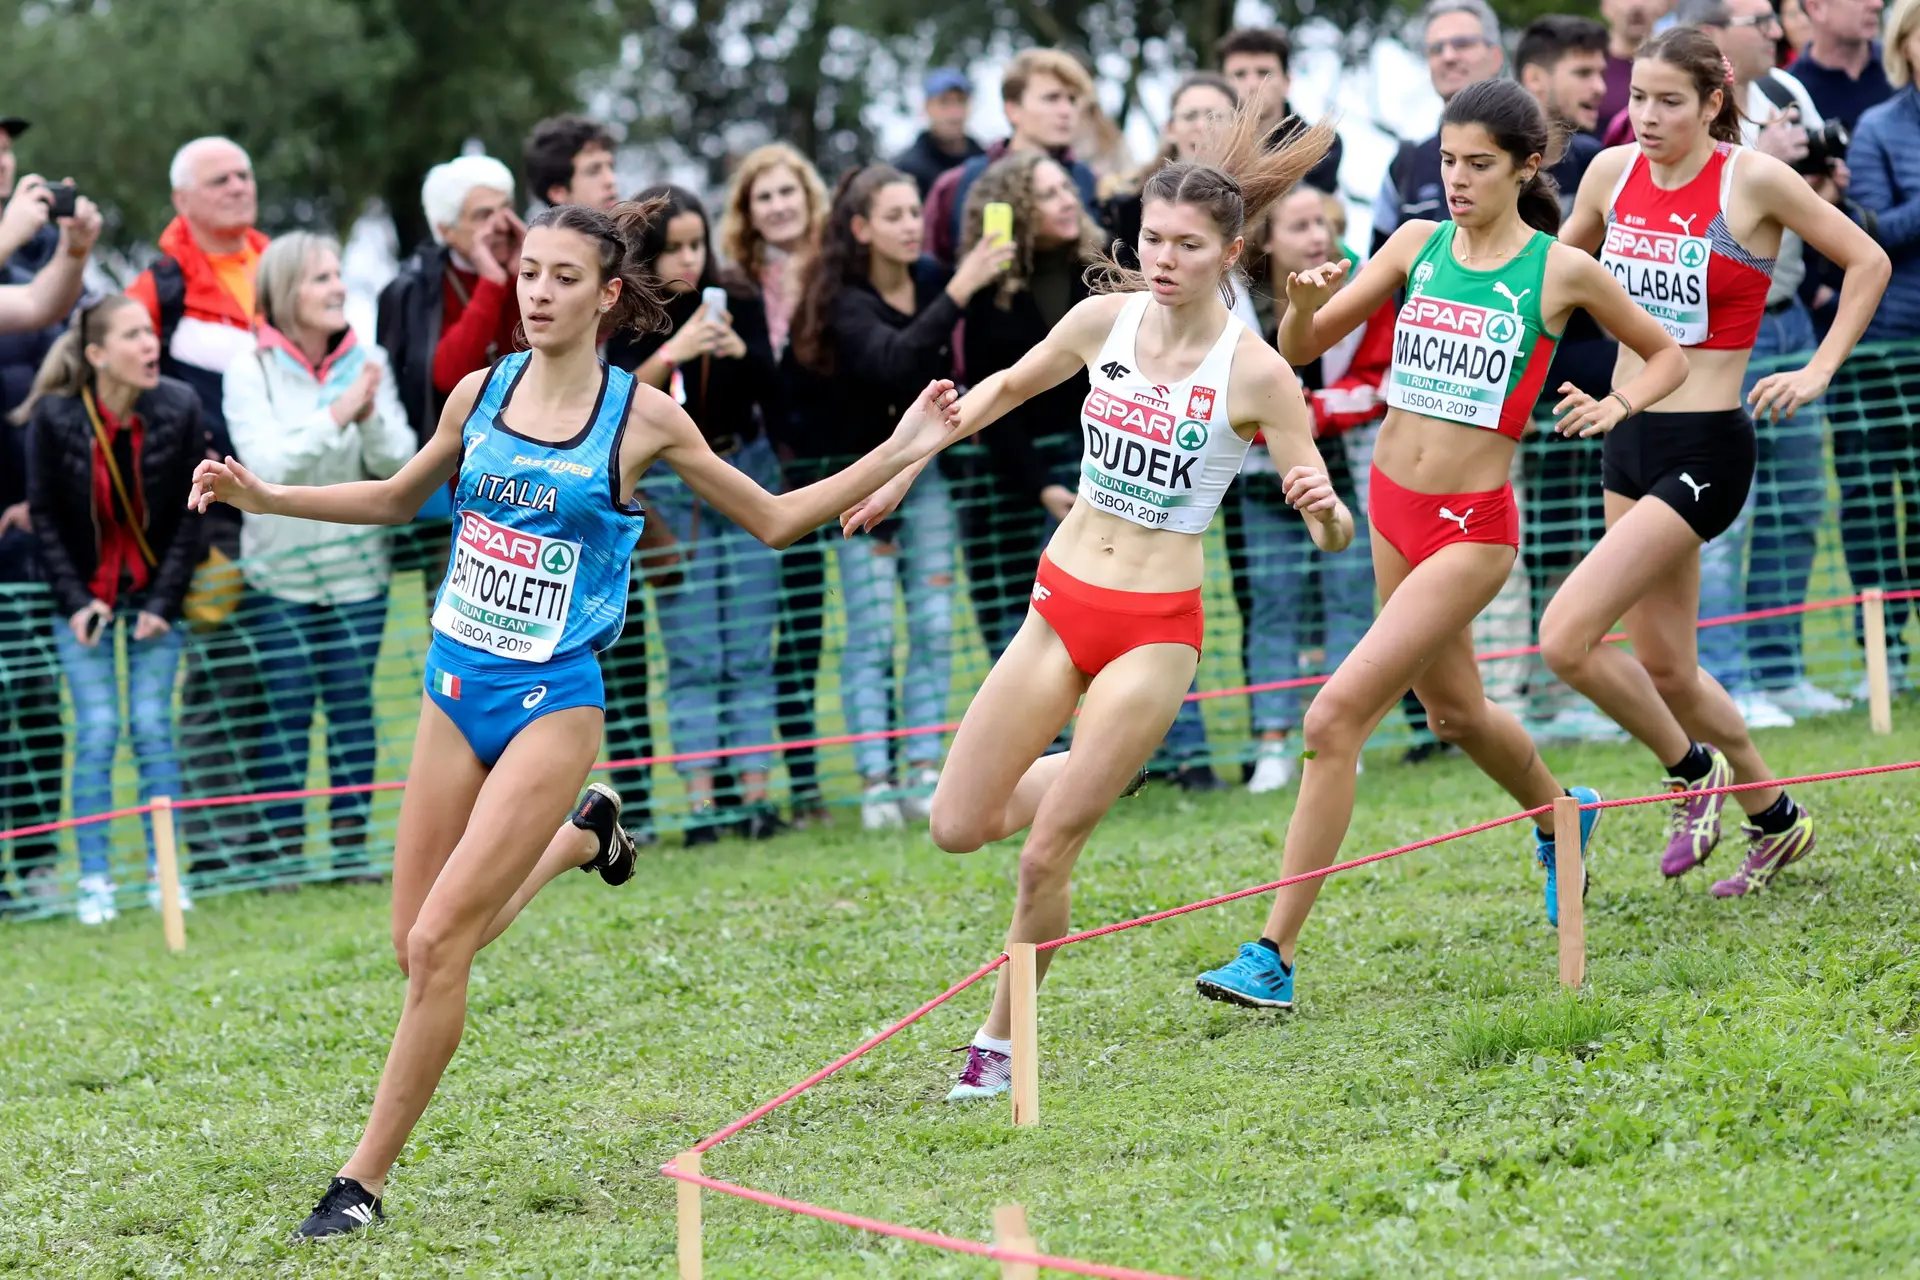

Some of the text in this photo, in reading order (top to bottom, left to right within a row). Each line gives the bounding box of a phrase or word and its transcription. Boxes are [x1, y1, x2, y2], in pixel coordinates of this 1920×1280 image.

[1606, 229, 1675, 261] SPAR
[1400, 299, 1483, 335] SPAR
[1395, 330, 1507, 384] MACHADO
[1406, 375, 1411, 385] I
[1411, 376, 1435, 390] RUN
[1086, 393, 1173, 440] SPAR
[1402, 391, 1478, 417] LISBOA 2019
[512, 455, 593, 478] FASTWEB
[1087, 423, 1199, 489] DUDEK
[476, 473, 558, 512] ITALIA
[1098, 475, 1123, 491] RUN
[1090, 486, 1169, 524] LISBOA 2019
[462, 516, 537, 564] SPAR
[451, 548, 568, 621] BATTOCLETTI
[461, 601, 482, 619] RUN
[451, 616, 532, 654] LISBOA 2019
